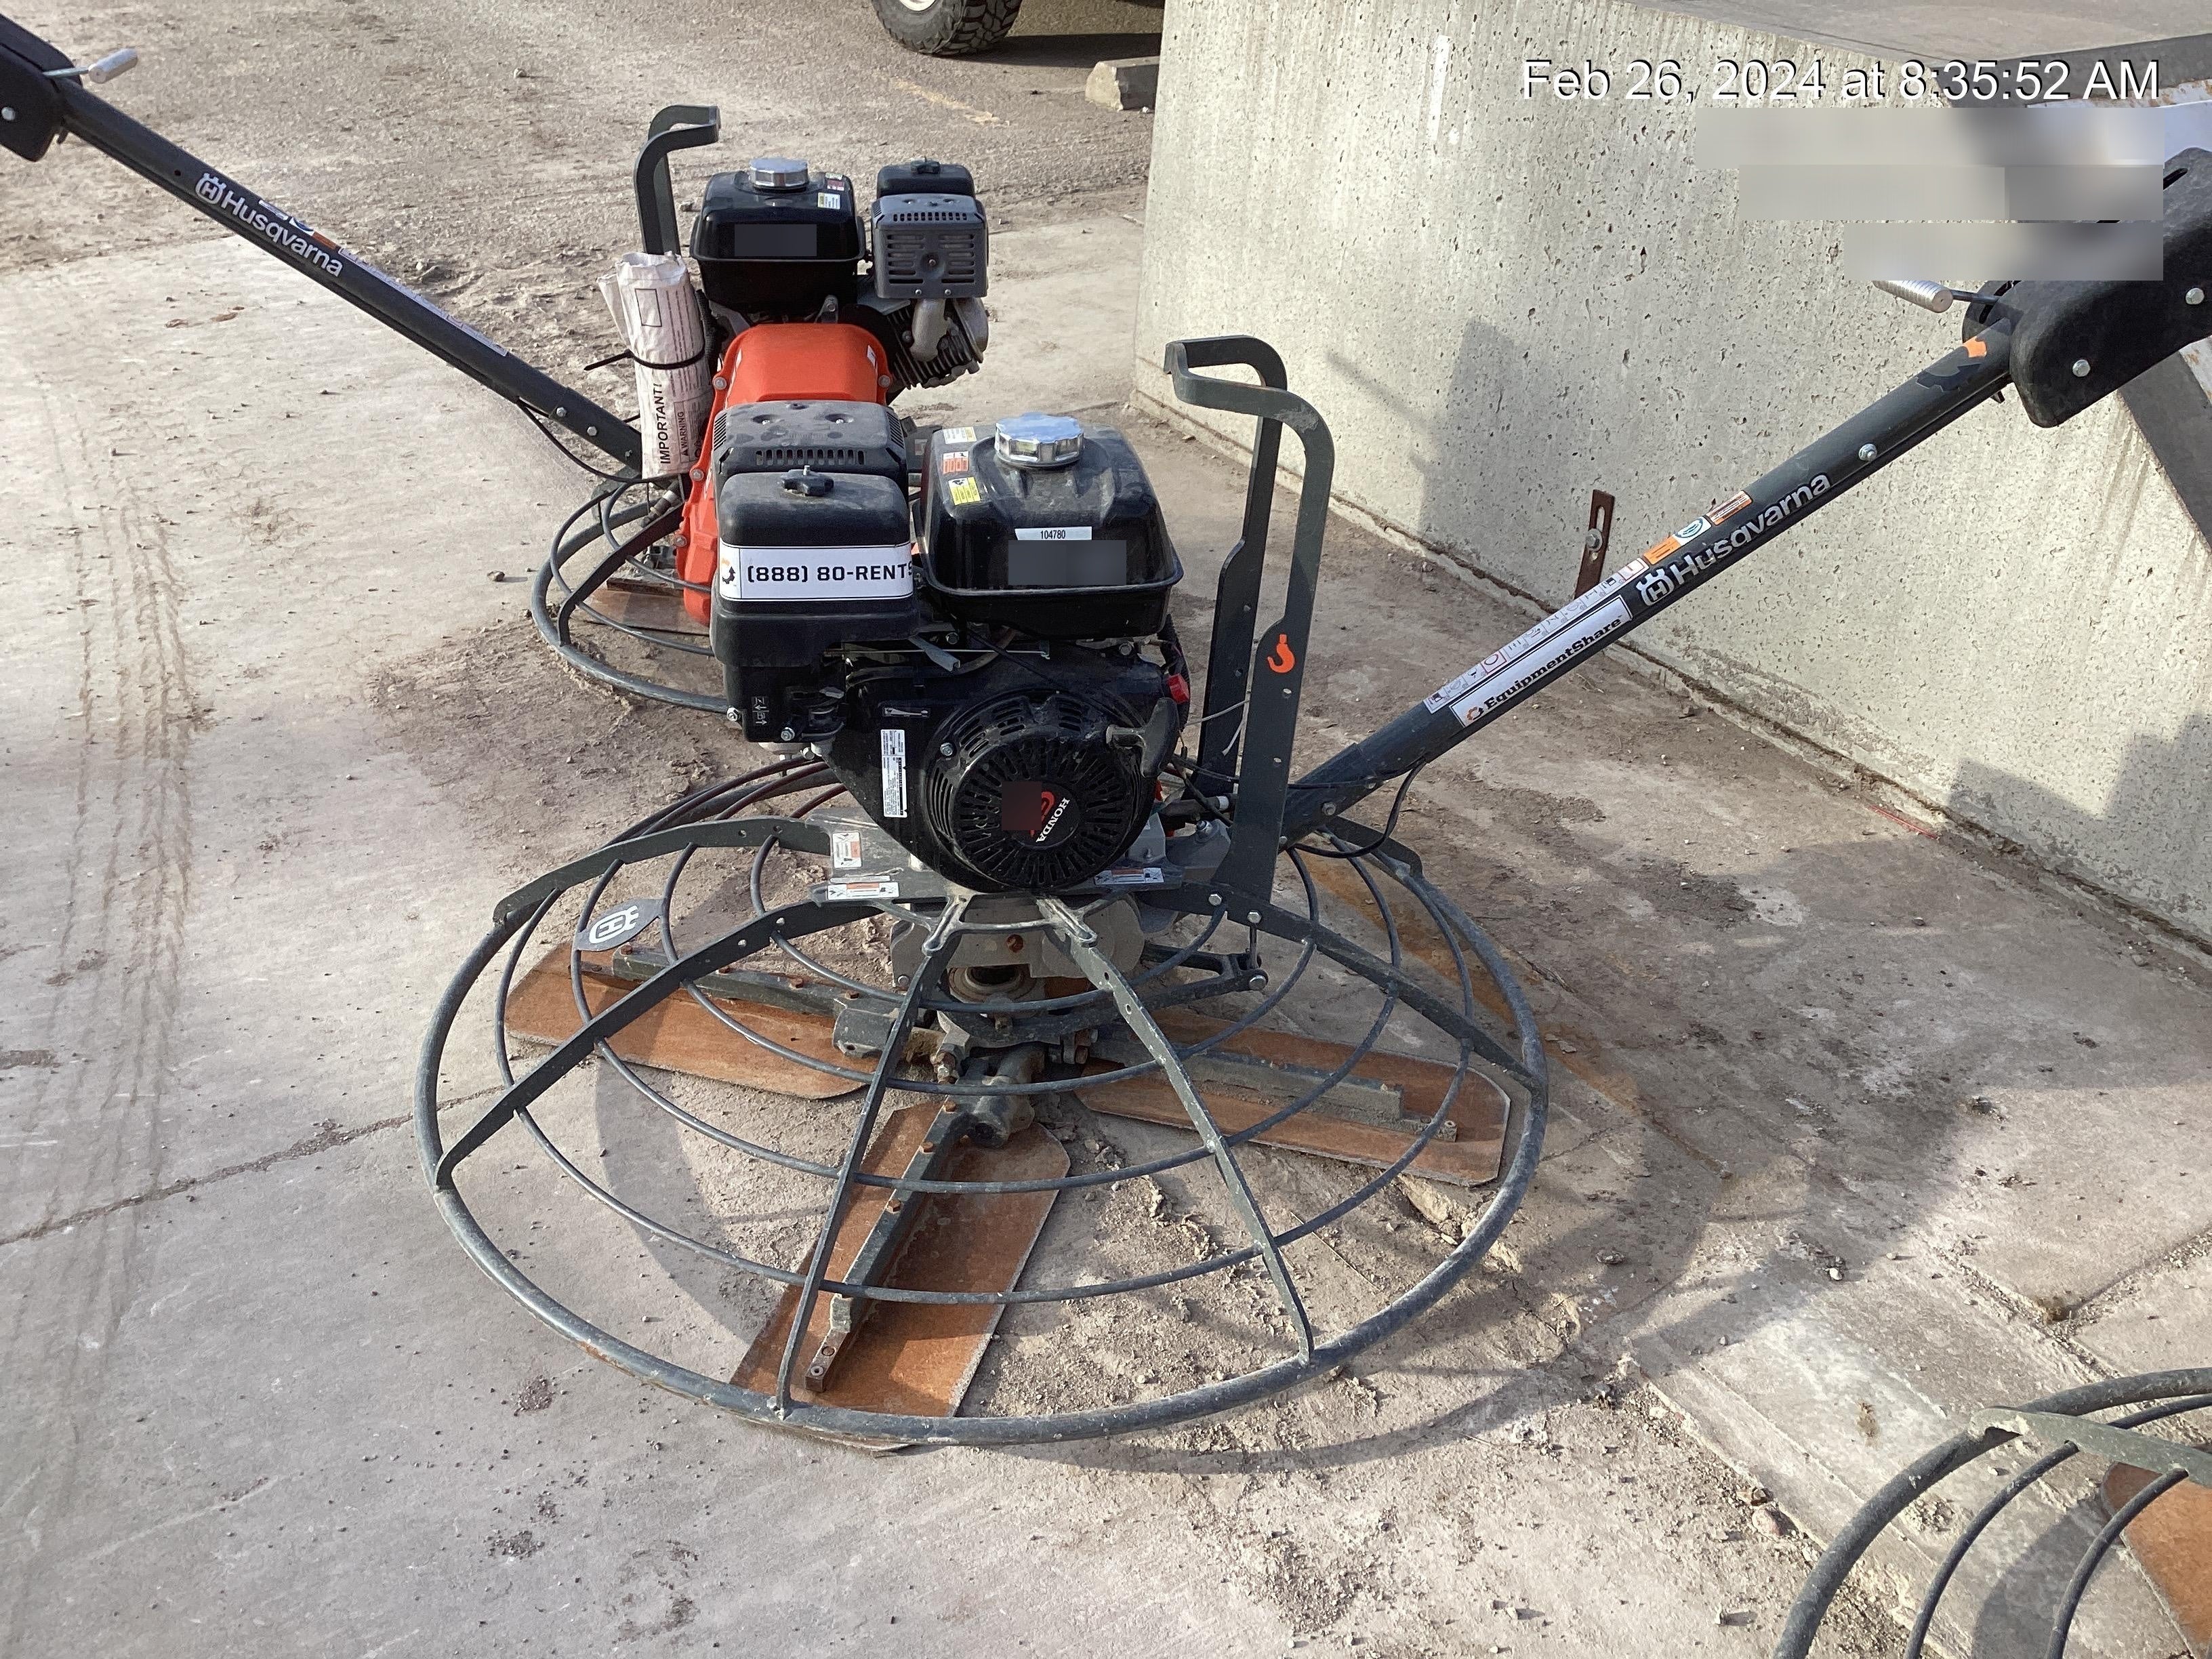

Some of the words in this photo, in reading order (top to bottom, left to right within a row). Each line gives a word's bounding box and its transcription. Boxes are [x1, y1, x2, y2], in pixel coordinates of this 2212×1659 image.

[221, 190, 343, 276] Husqvarna
[653, 383, 671, 464] IMPORTANT!
[678, 411, 689, 449] WARNING
[1040, 530, 1066, 539] 104780
[1669, 474, 1831, 585] Husqvarna
[747, 565, 808, 583] (888)
[1484, 617, 1621, 710] EquipmentShare
[1036, 798, 1070, 842] HONDA
